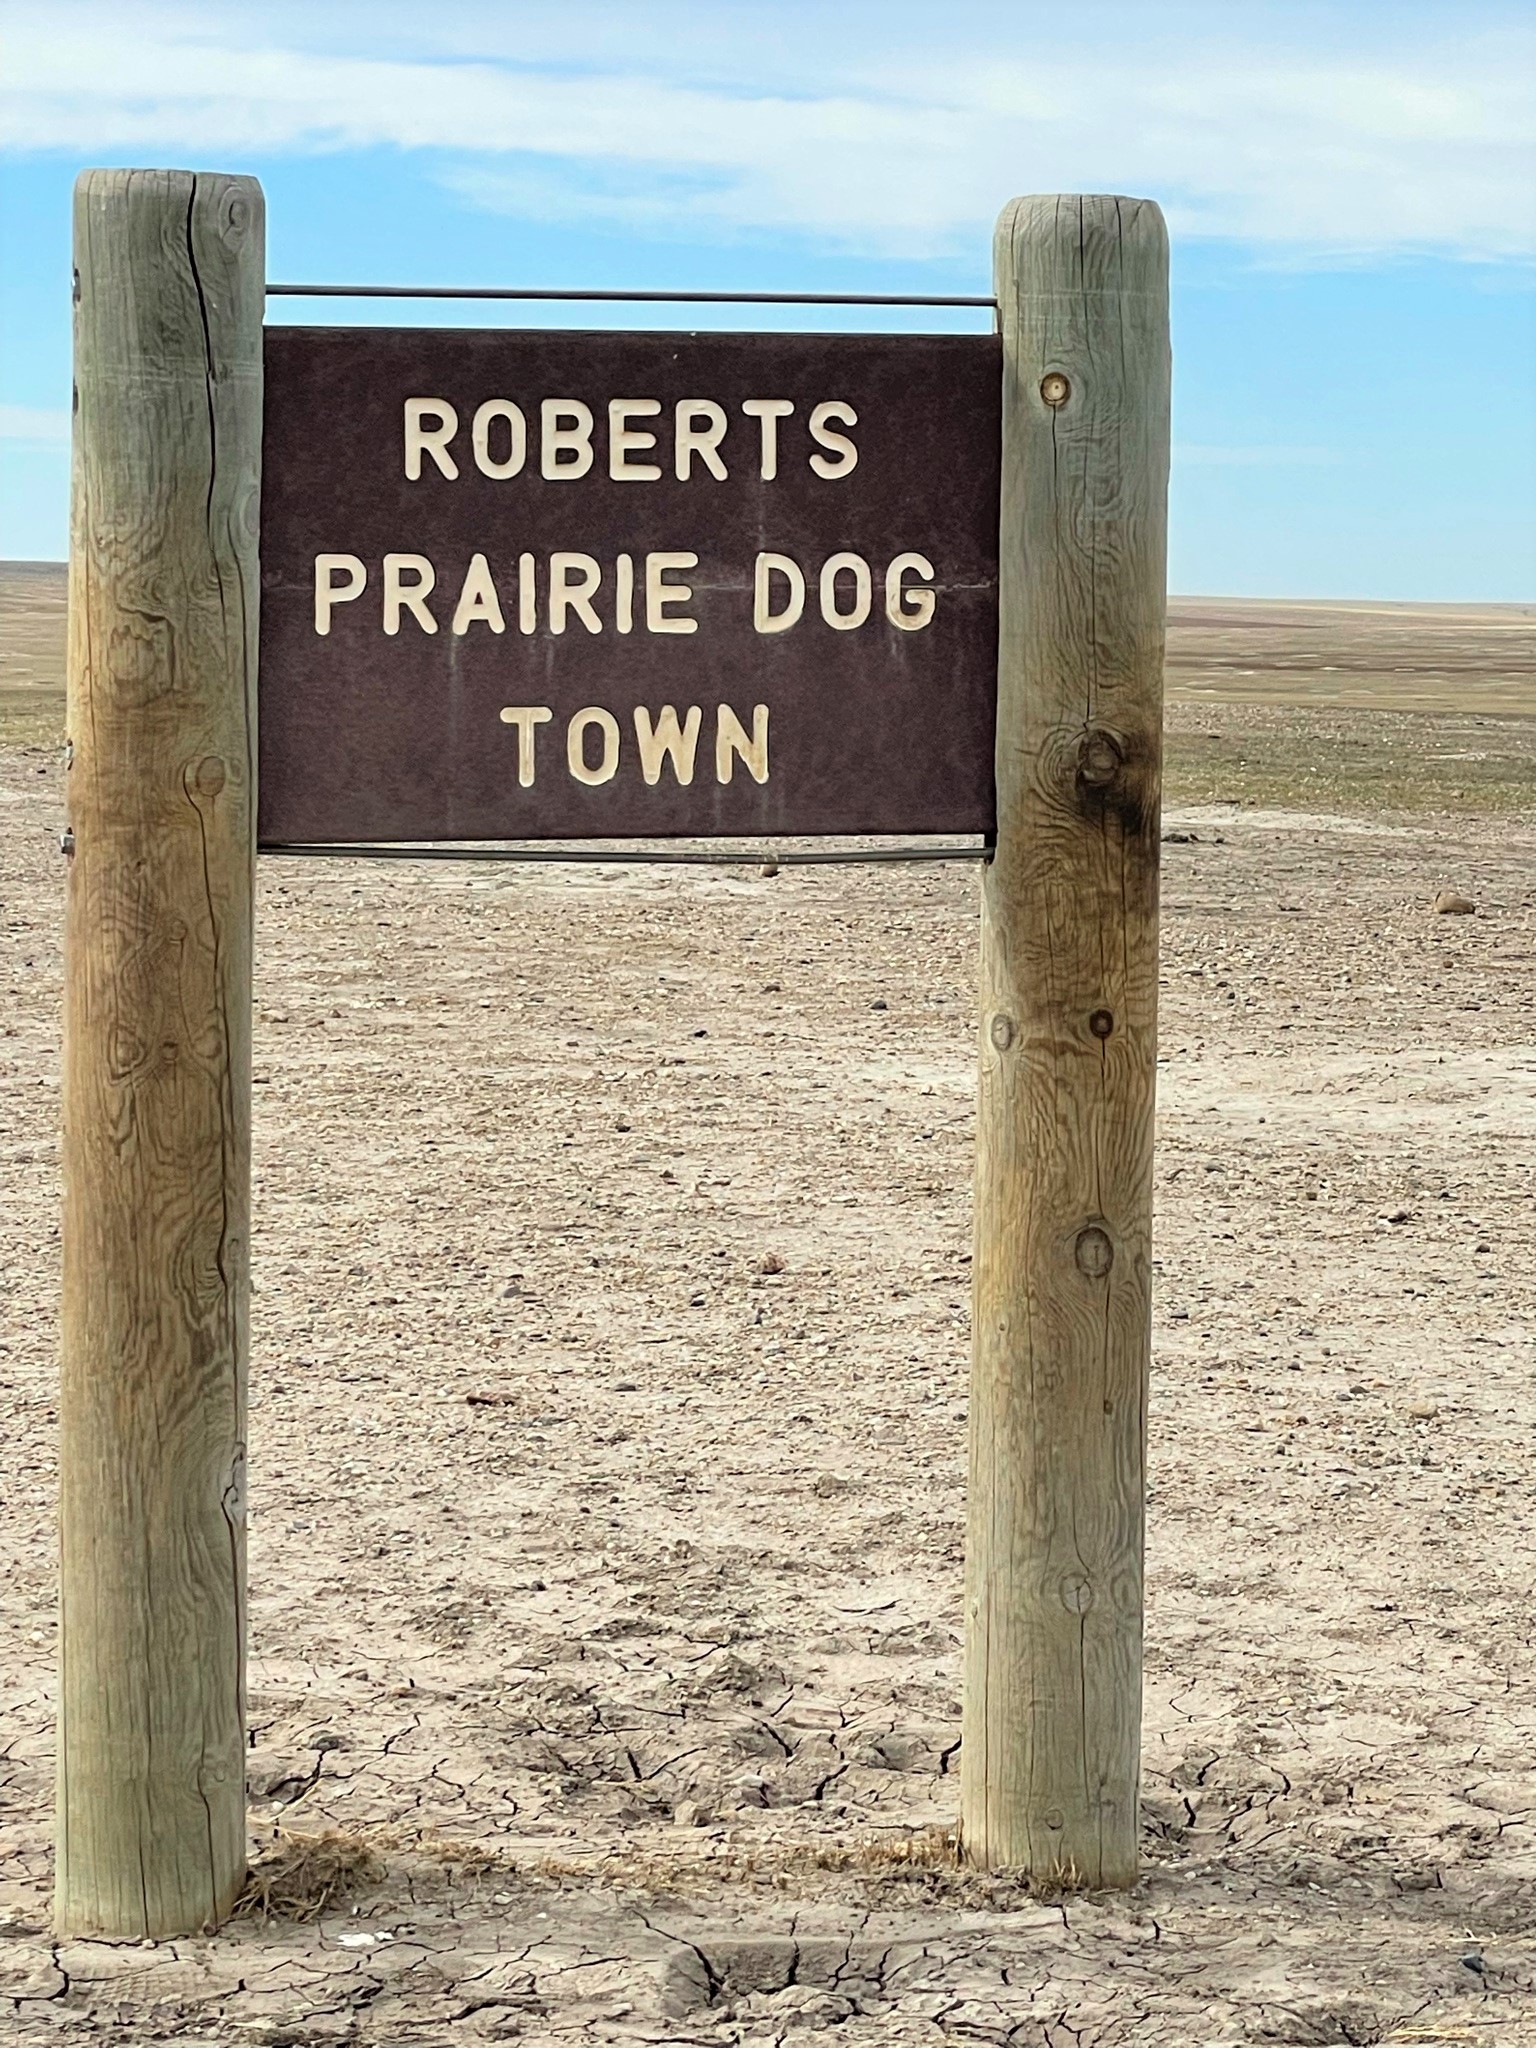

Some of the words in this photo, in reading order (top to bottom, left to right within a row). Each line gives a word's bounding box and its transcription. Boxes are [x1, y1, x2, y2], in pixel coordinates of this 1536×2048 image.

[404, 398, 859, 482] ROBERTS
[314, 552, 699, 636] PRAIRIE
[753, 552, 937, 635] DOG
[499, 703, 771, 788] TOWN
